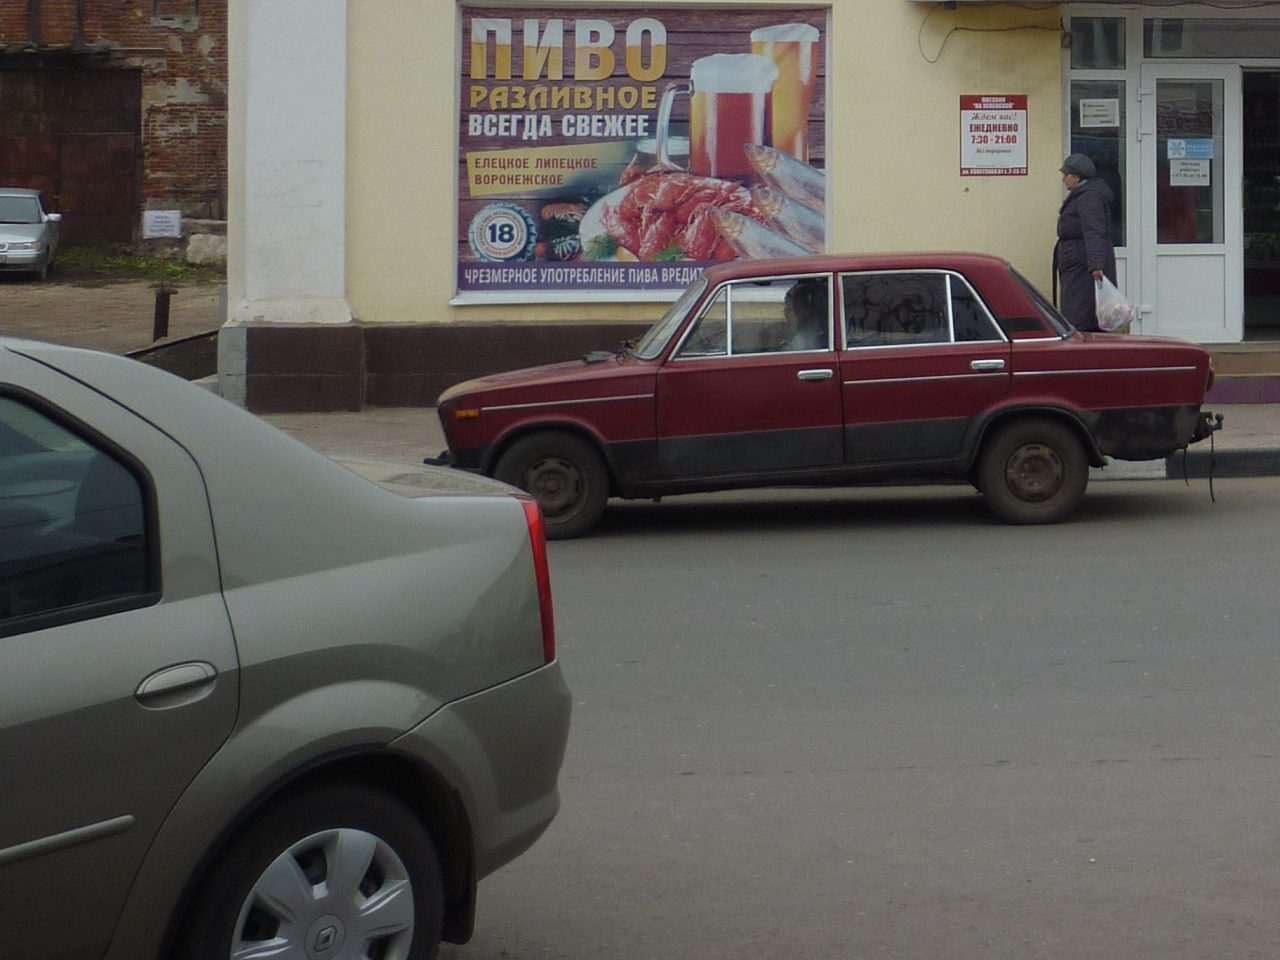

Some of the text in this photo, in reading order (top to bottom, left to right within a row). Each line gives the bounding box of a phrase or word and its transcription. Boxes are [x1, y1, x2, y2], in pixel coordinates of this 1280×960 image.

[470, 17, 667, 82] ПИВО
[469, 84, 657, 111] РАЗЛИВНОЕ
[468, 113, 649, 140] ВСЕГДА СВЕЖЕЕ
[969, 123, 1019, 133] ЕЖЕДНЕВНО
[474, 157, 598, 170] ЕЛЕЦКОЕ ЛИПЕЦКОЕ
[474, 173, 564, 185] ВОРОНЕЖСКОЕ
[488, 223, 515, 243] 18
[464, 268, 537, 284] ЧРЕЗМЕРНОЕ
[540, 268, 625, 284] УПОТРЕБЛЕНИЕ
[628, 268, 658, 283] ПИВА
